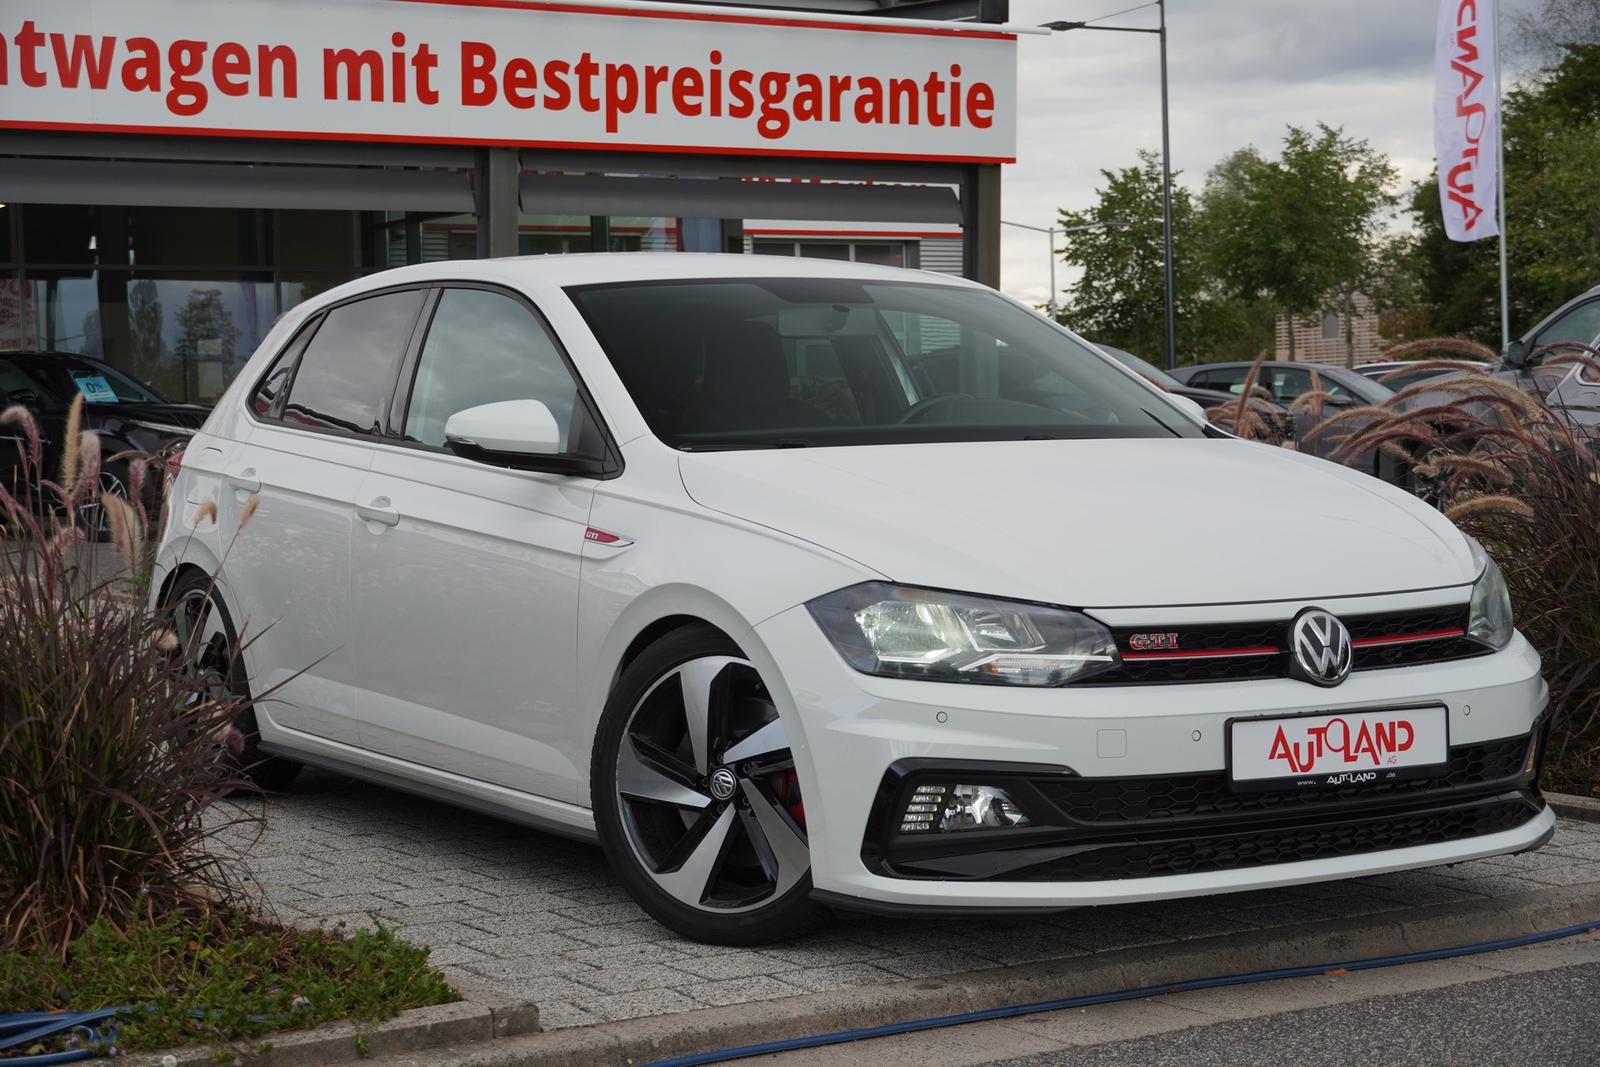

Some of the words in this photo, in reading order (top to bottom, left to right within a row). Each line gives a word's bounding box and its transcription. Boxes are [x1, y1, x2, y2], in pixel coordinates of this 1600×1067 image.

[0, 21, 298, 116] twagen
[322, 31, 440, 106] mit
[460, 41, 996, 139] Bestpreisgarantie
[585, 531, 599, 540] GTI
[1129, 632, 1179, 651] GTI
[1268, 718, 1415, 774] AUTOLAND
[1387, 755, 1397, 765] AG
[1326, 772, 1377, 785] AUTOLAND
